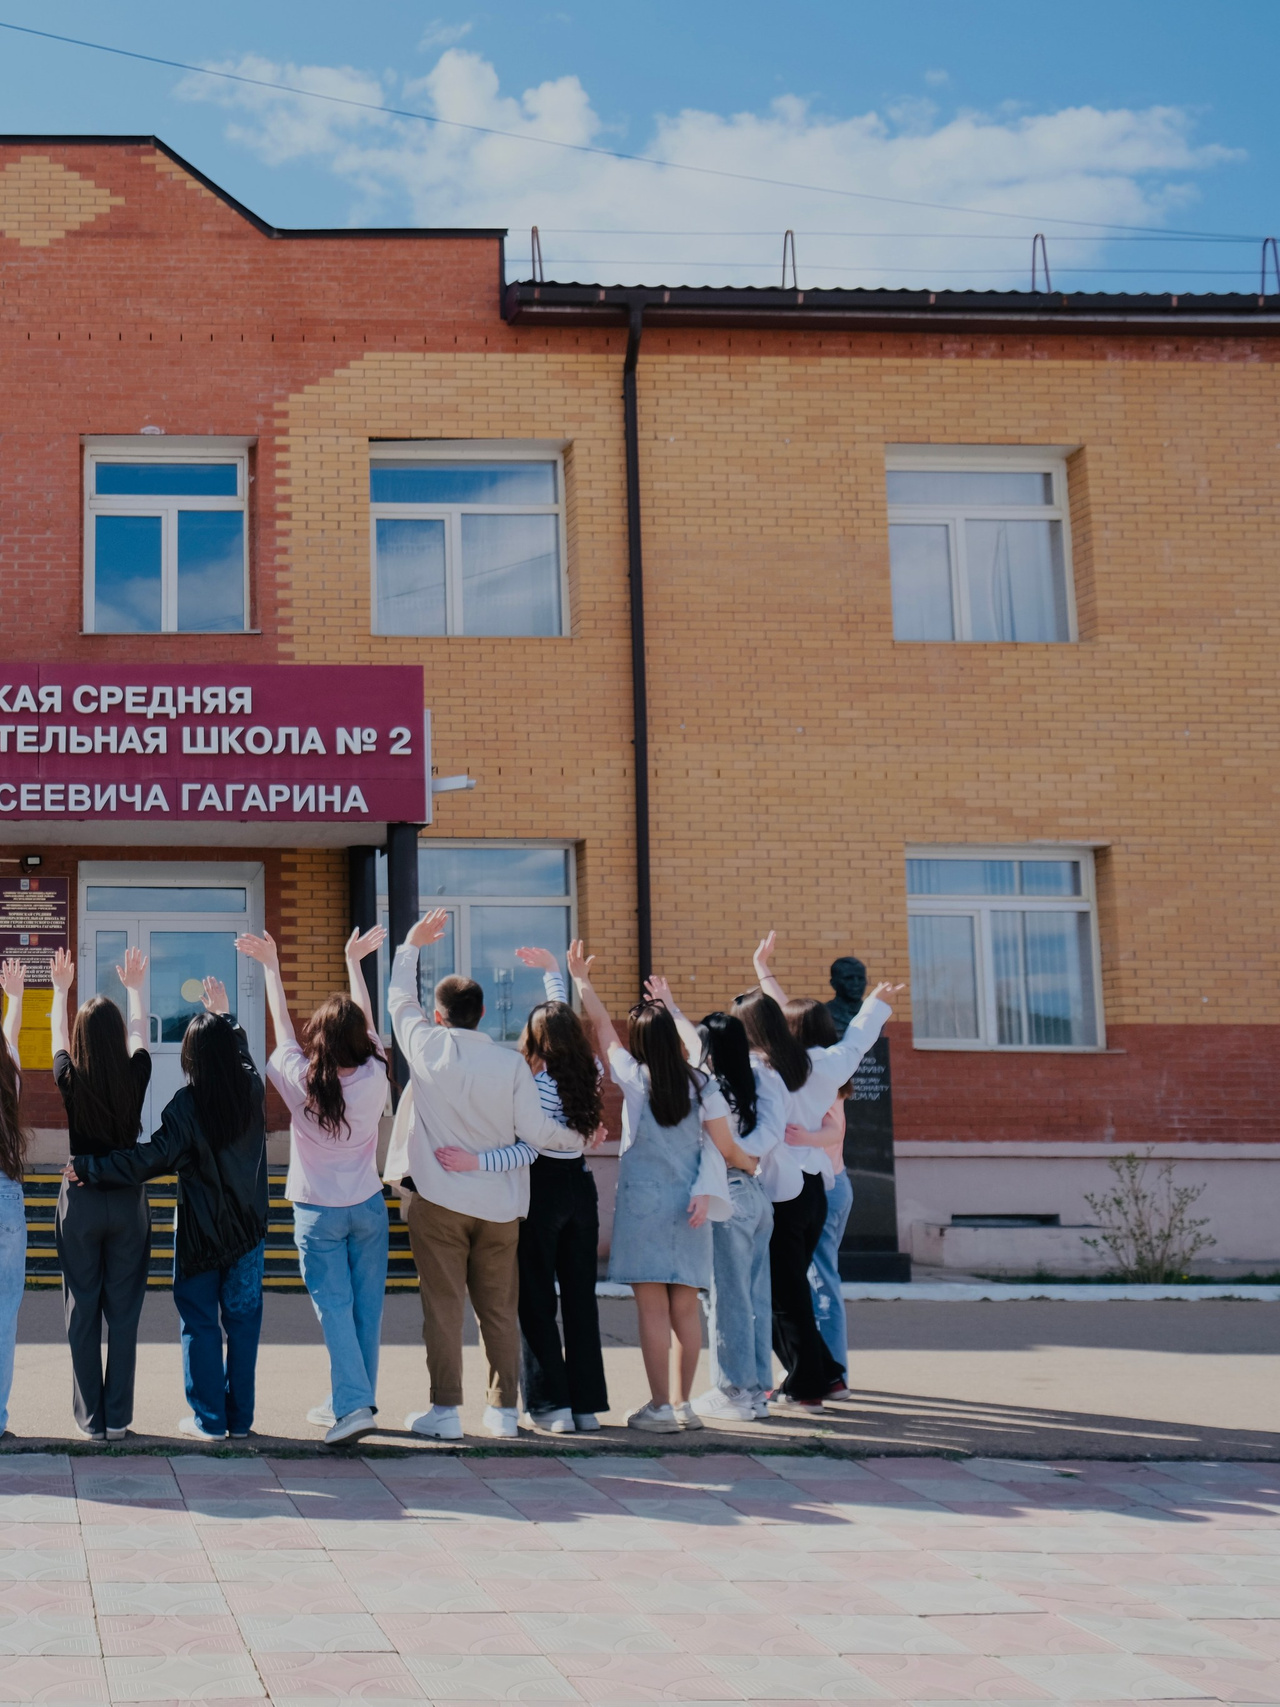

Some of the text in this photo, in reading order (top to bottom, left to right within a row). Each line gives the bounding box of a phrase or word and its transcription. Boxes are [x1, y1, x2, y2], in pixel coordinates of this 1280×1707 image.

[72, 684, 252, 719] СРЕДНЯЯ
[182, 725, 327, 755] ШКОЛА
[336, 726, 378, 755] №
[389, 726, 412, 755] 2
[181, 783, 369, 813] ГАГАРИНА
